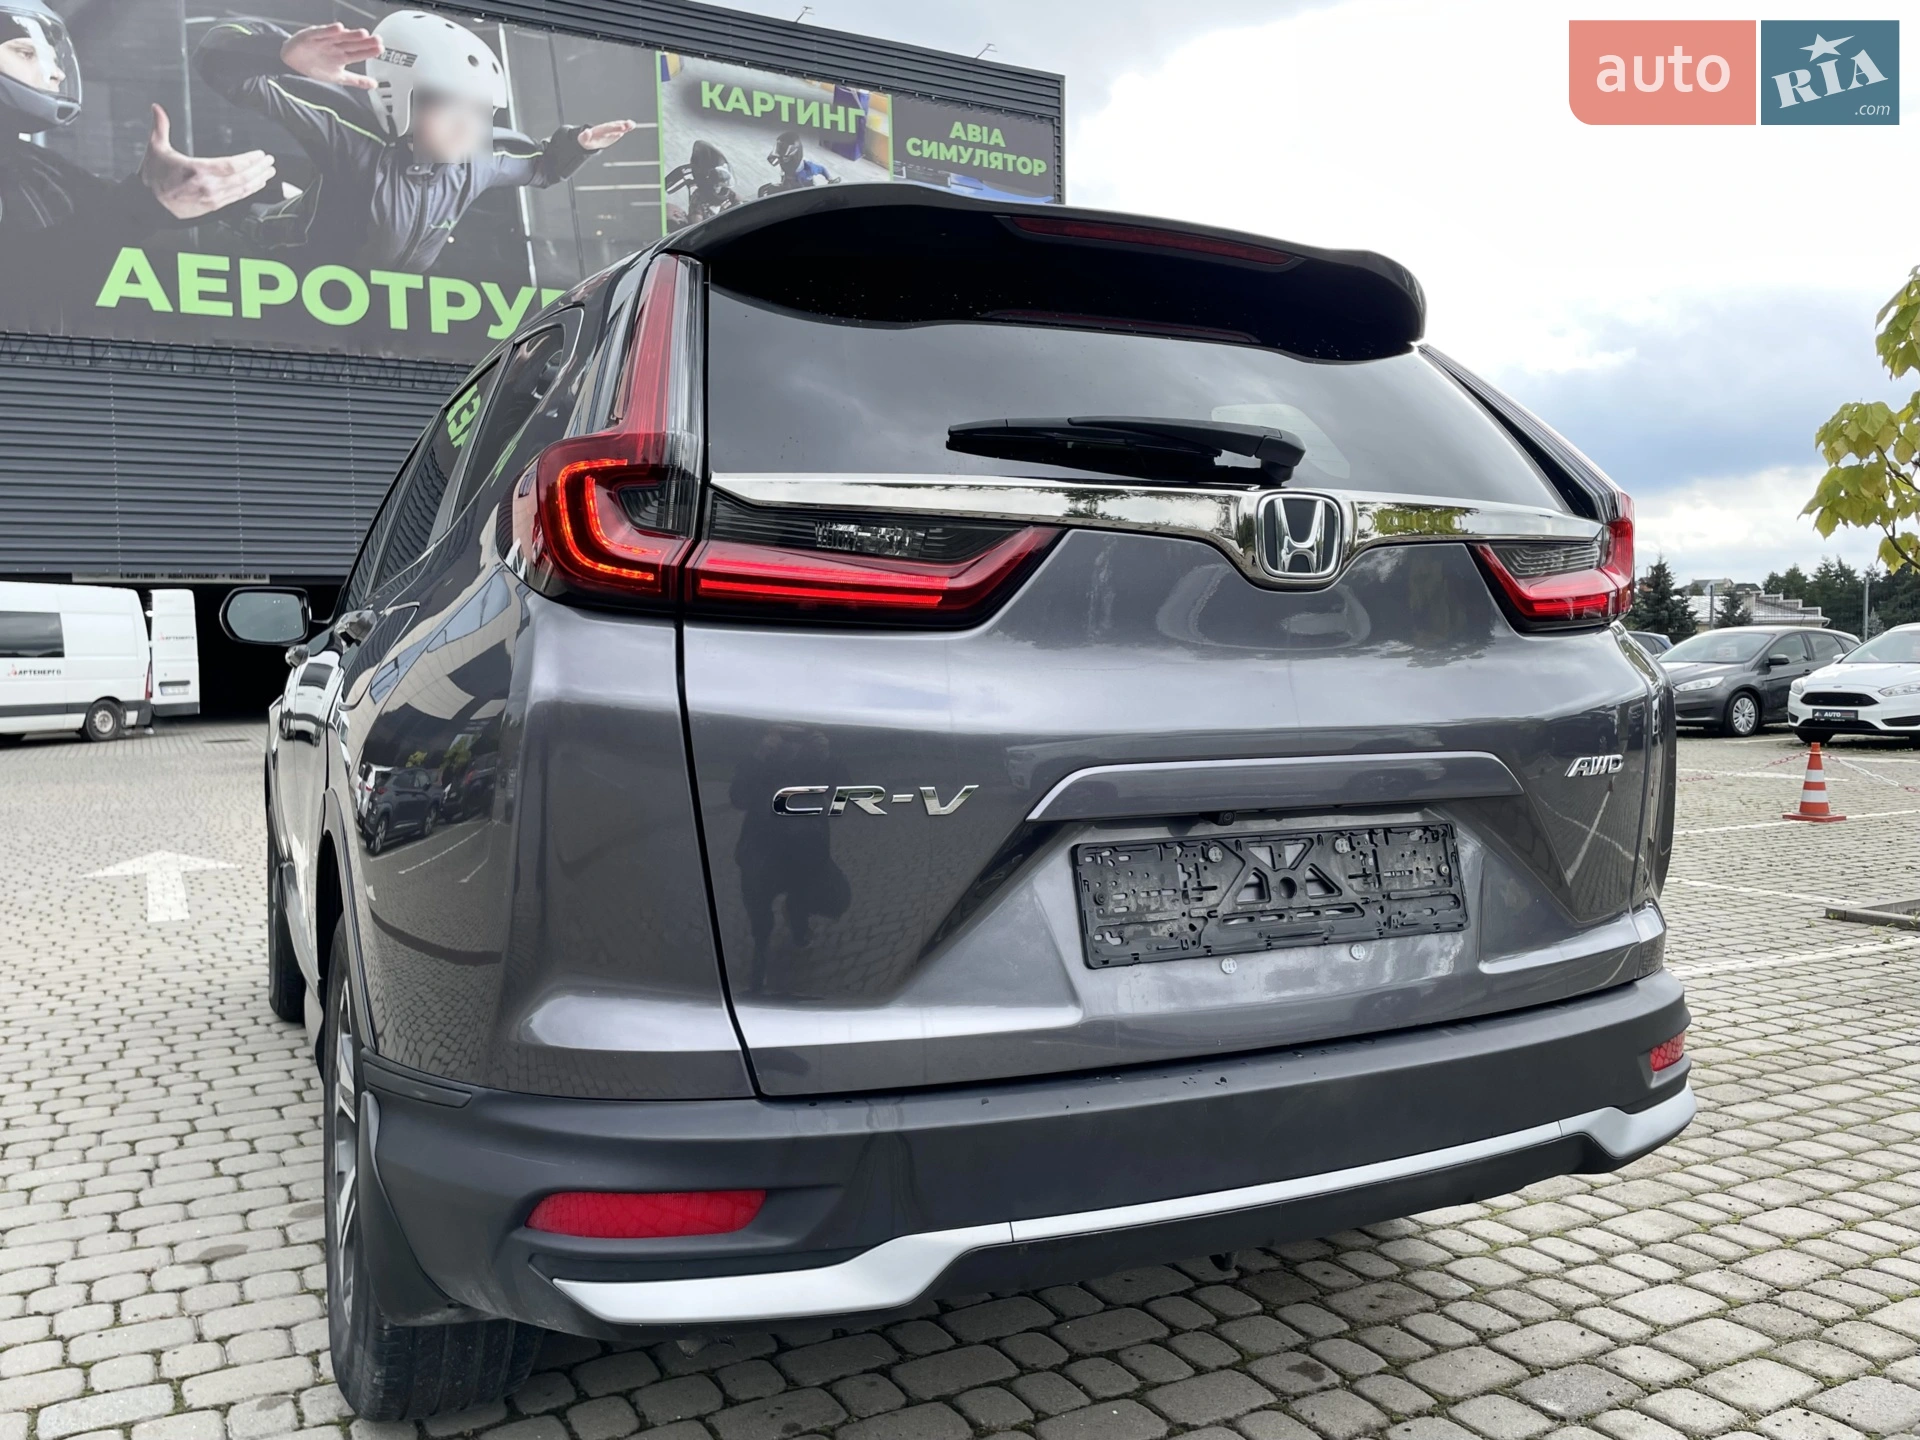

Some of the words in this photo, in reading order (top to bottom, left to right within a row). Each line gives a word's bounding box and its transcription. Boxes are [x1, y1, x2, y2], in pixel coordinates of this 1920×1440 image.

[701, 80, 867, 134] КАРТИНГ
[949, 120, 1006, 149] АВІА
[905, 137, 1048, 177] СИМУЛЯТОР
[96, 246, 568, 341] АЕРОТРУ
[1564, 754, 1625, 777] AWD
[772, 784, 980, 816] CR-V
